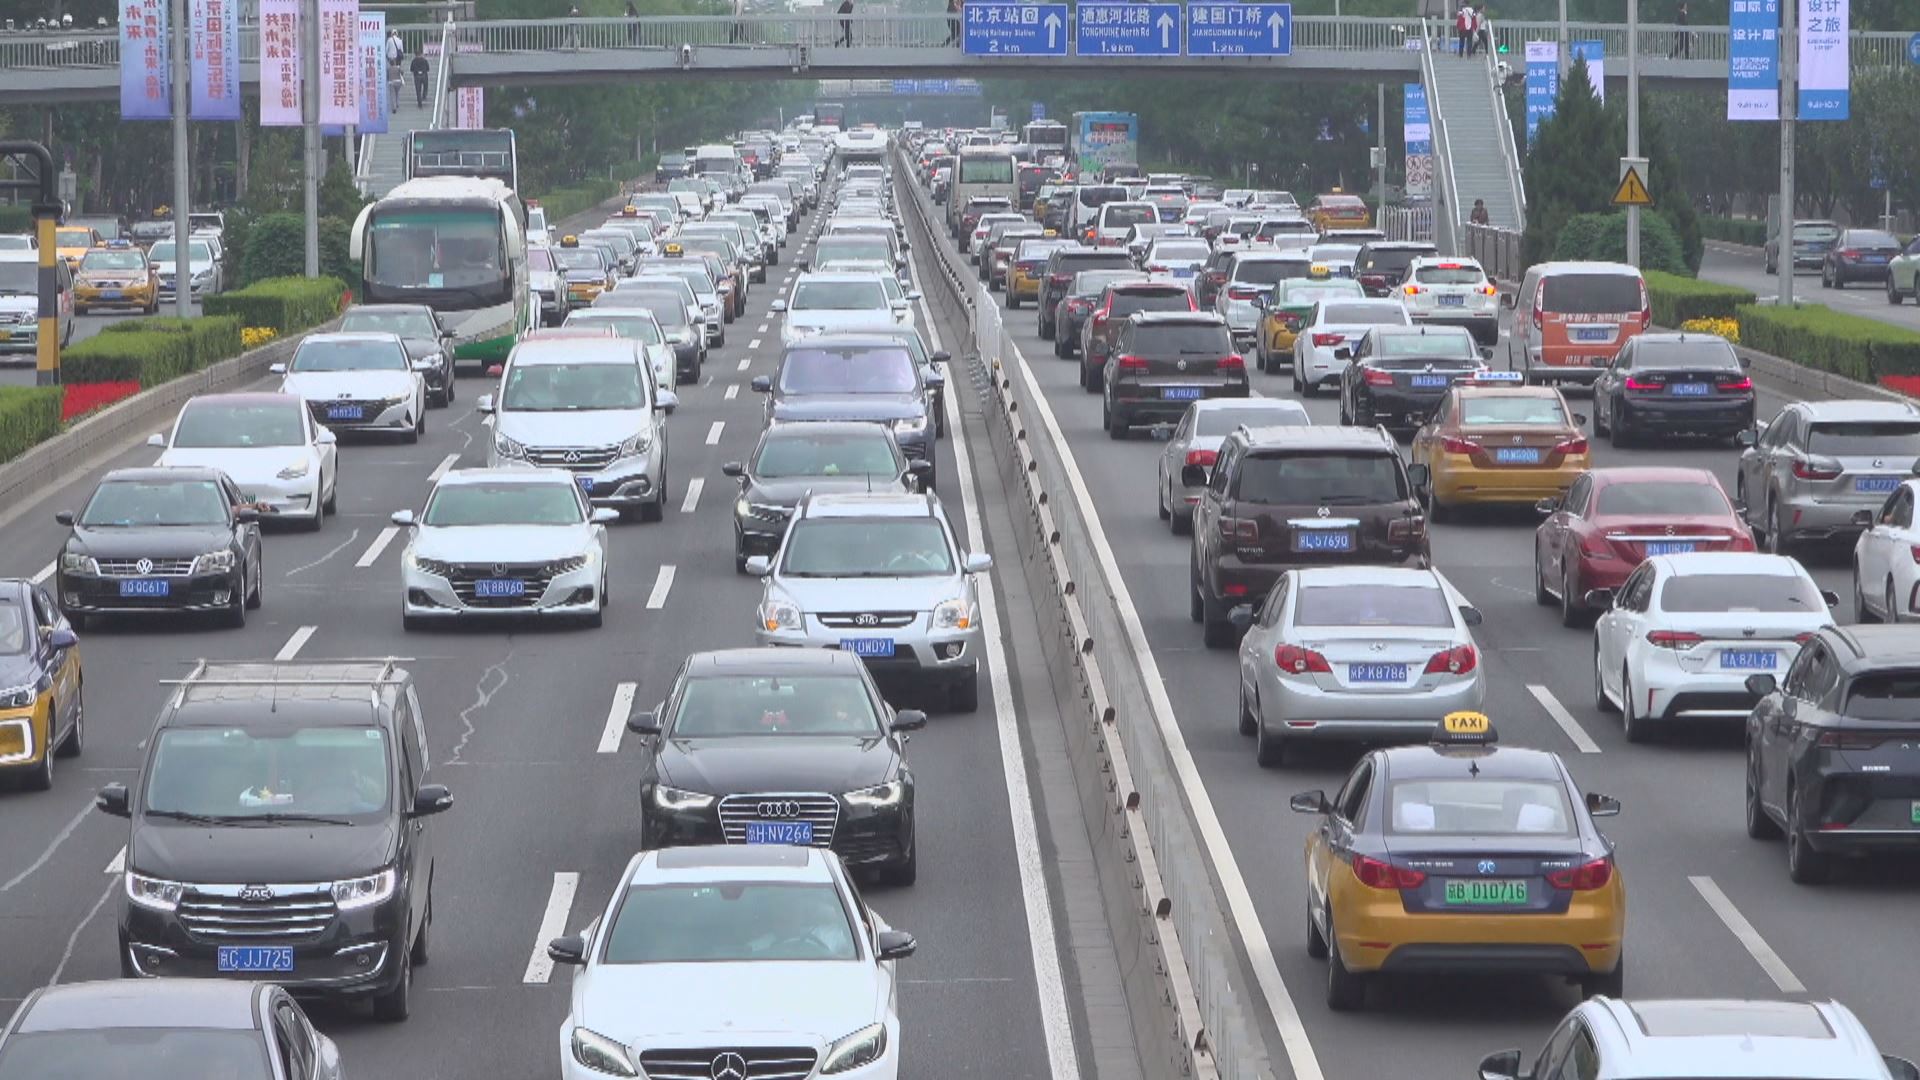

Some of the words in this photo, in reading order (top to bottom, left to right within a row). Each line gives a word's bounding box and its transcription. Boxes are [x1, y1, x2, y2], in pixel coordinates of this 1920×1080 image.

[1808, 0, 1841, 13] 设计
[968, 7, 1020, 24] 北京站
[1081, 7, 1150, 24] 通惠河北路
[1192, 7, 1262, 24] 建国门桥
[1808, 17, 1841, 32] 之旅
[265, 13, 280, 59] 共未来
[969, 28, 989, 38] Beijing
[990, 28, 1012, 38] Railway
[1014, 28, 1036, 37] Station
[1081, 27, 1119, 38] TONGHUIHE
[1120, 27, 1140, 37] North
[1140, 27, 1150, 37] Rd
[1192, 28, 1237, 37] JIANGUOMEN
[1238, 28, 1262, 39] Bridge
[1732, 28, 1776, 41] 设计周
[989, 40, 999, 53] 2
[1004, 42, 1020, 53] km
[333, 11, 347, 108] 北京国际音乐节
[1450, 717, 1483, 729] TAXI
